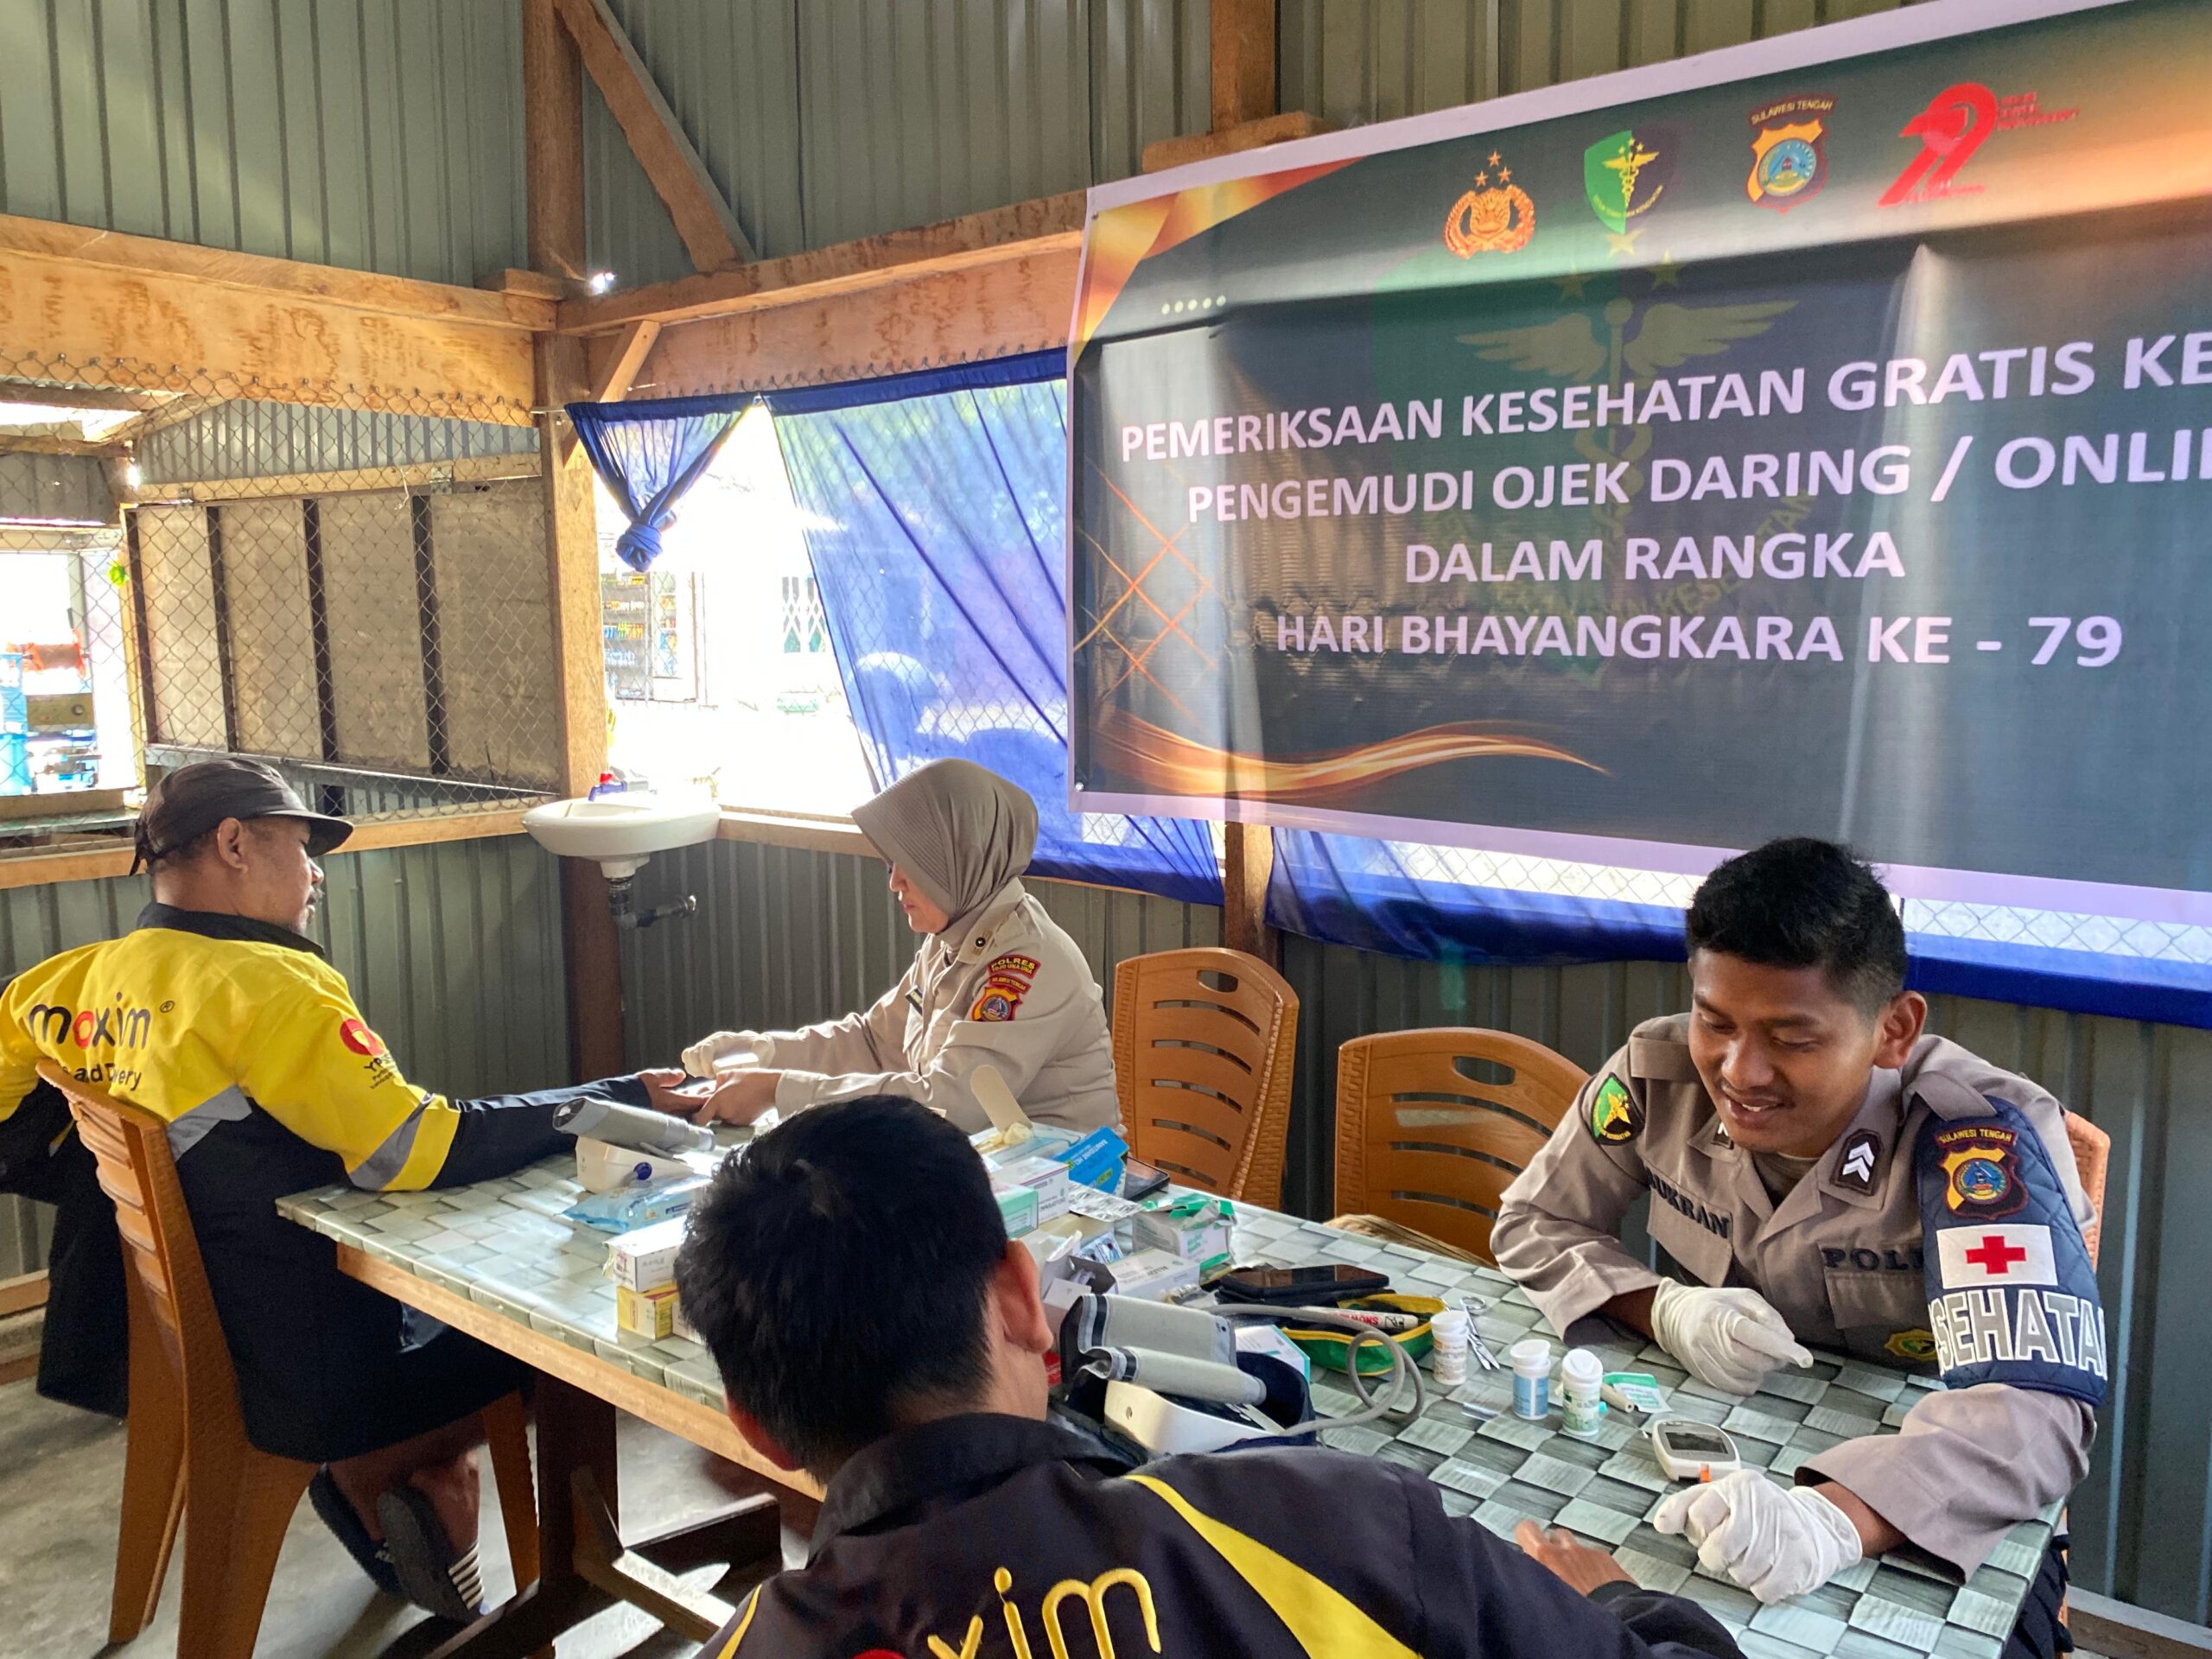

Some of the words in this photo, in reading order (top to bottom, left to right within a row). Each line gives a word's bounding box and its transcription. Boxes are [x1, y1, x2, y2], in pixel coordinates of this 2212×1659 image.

[1122, 399, 1443, 462] PEMERIKSAAN
[1463, 368, 1806, 437] KESEHATAN
[1827, 341, 2095, 412] GRATIS
[1187, 471, 1473, 523] PENGEMUDI
[1492, 461, 1630, 510] OJEK
[1650, 445, 1911, 503] DARING
[1929, 435, 1974, 503] /
[1994, 428, 2212, 490] ONLI
[1406, 539, 1604, 583] DALAM
[1624, 532, 1907, 580] RANGKA
[1277, 615, 1382, 653] HARI
[1402, 615, 1844, 662] BHAYANGKARA
[1868, 615, 1952, 664] KE
[1976, 640, 2002, 652] -
[2028, 615, 2123, 667] 79
[991, 957, 1036, 969] POLRES
[1938, 1129, 1977, 1143] SULAWESI
[1979, 1128, 2012, 1141] TENGAH
